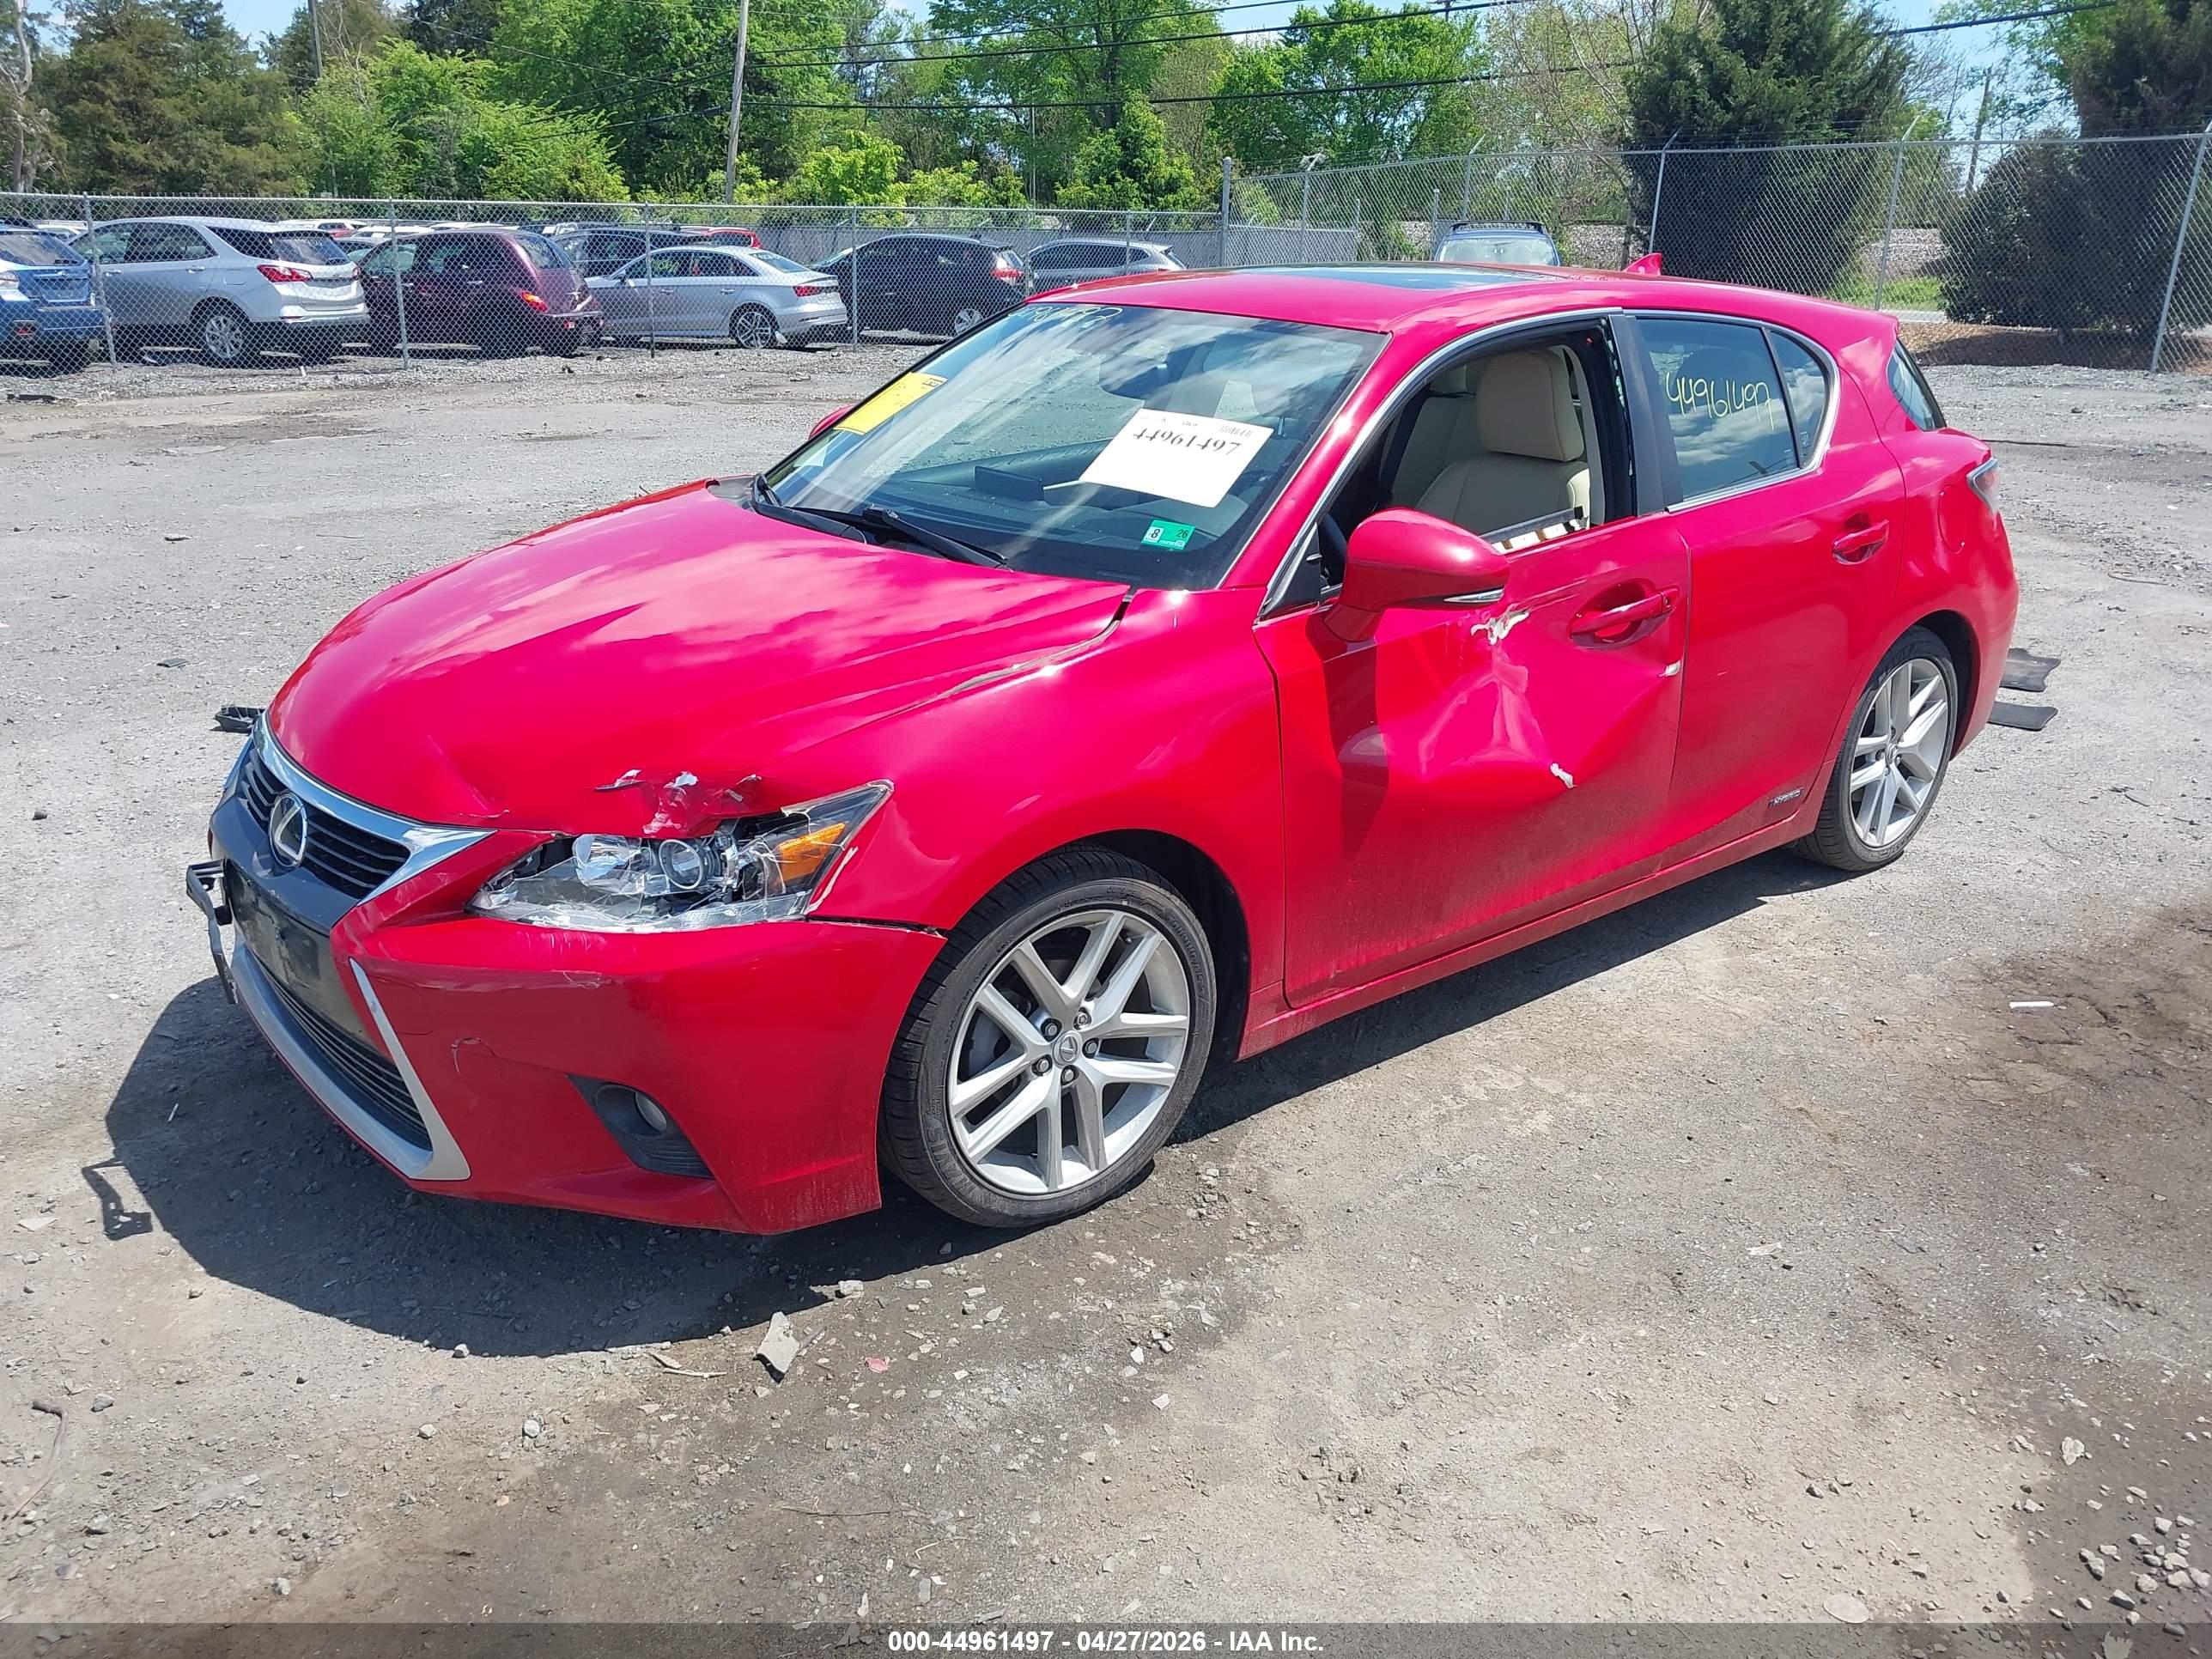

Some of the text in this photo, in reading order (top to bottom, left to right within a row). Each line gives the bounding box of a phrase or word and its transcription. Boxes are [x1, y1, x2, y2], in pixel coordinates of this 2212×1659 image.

[1665, 371, 1775, 432] 44961497
[1132, 428, 1243, 456] 44961497
[1151, 528, 1189, 539] 8 26
